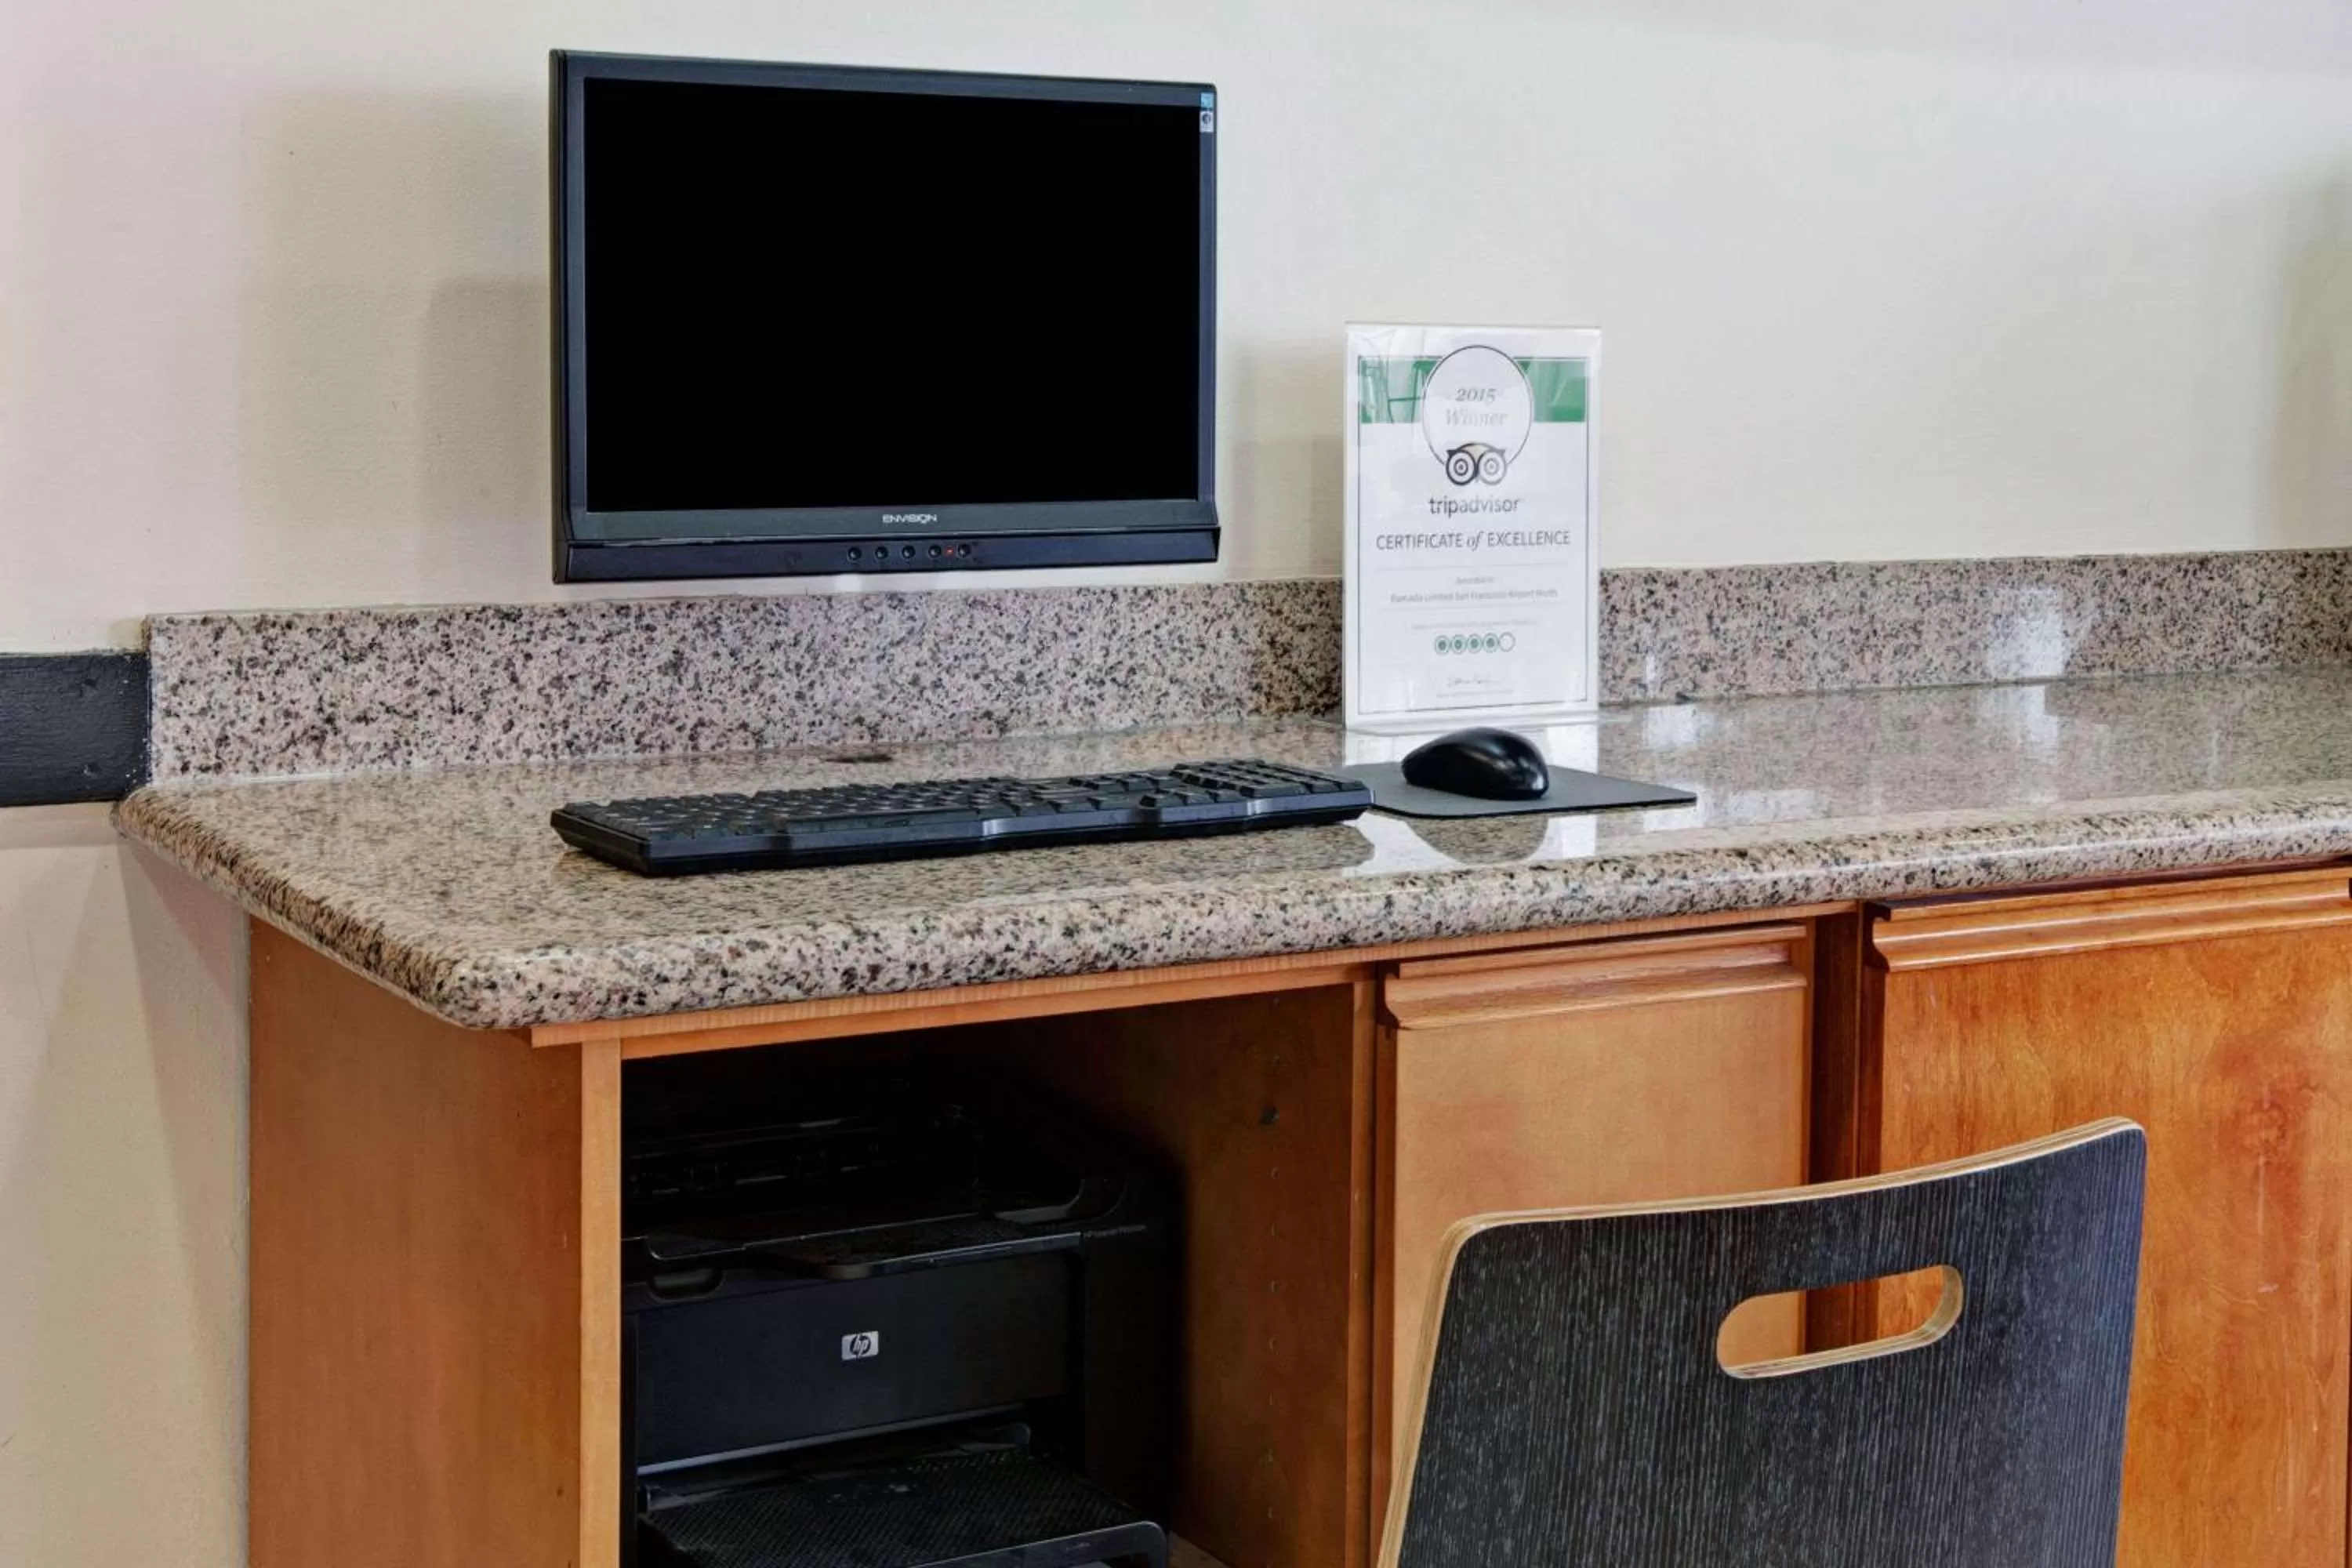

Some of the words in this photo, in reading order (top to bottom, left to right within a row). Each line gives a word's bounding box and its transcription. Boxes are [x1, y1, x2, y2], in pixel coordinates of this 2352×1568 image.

[1454, 387, 1497, 405] 2015
[1445, 408, 1508, 426] Winner
[1428, 495, 1521, 518] tripadvisor
[881, 514, 938, 524] ENVISION
[1376, 532, 1464, 550] CERTIFICATE
[1466, 531, 1484, 552] of
[1486, 530, 1571, 547] EXCELLENCE
